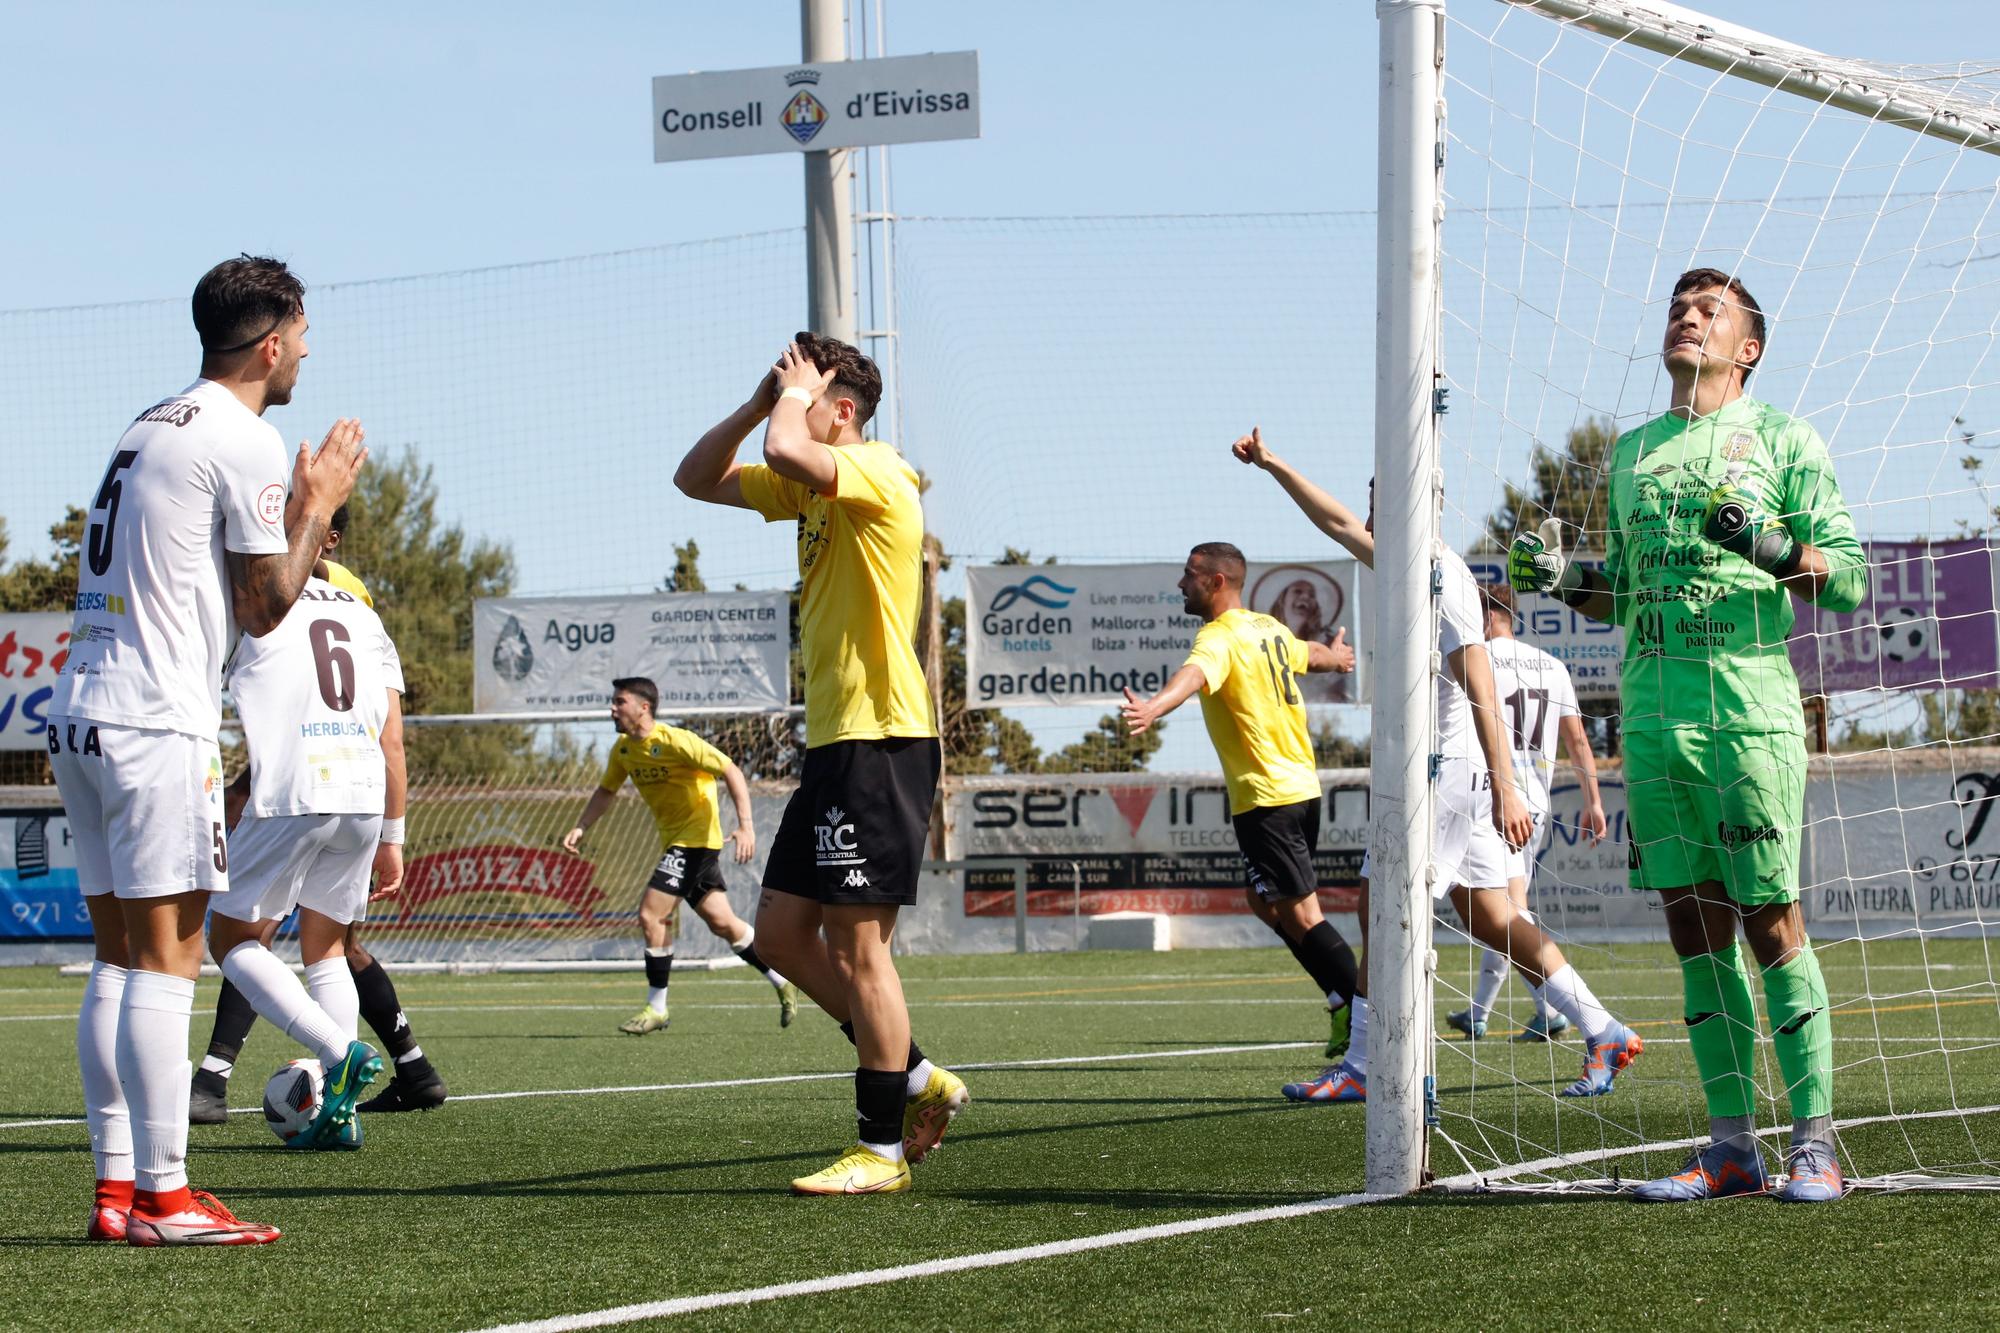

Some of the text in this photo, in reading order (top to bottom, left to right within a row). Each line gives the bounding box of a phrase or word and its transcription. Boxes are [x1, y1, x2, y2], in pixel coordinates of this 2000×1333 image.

[661, 89, 971, 134] Consell d'Eivissa
[1648, 491, 1711, 501] Mediterrá
[88, 449, 139, 577] 5
[1632, 523, 1700, 544] BLAKST
[1868, 548, 1946, 602] ELE
[300, 588, 355, 603] ALO
[1090, 593, 1117, 605] Live
[1158, 591, 1185, 605] Fee
[651, 607, 776, 623] GARDEN CENTER
[982, 612, 1072, 635] Garden
[1091, 616, 1156, 630] Mallorca
[543, 619, 616, 651] Agua
[1675, 617, 1736, 634] destino
[651, 635, 698, 645] PLANTAS
[699, 635, 706, 643] Y
[1003, 637, 1052, 652] hotels
[1091, 636, 1191, 651] Ibiza Huelva
[1685, 633, 1726, 649] pacha
[308, 618, 356, 713] 6
[1260, 635, 1299, 707] 18
[978, 664, 1169, 700] gardenhotel
[1504, 687, 1549, 752] 17
[301, 722, 367, 737] HERBUSA
[814, 823, 858, 851] RC
[212, 821, 228, 874] 5
[828, 851, 858, 859] CENTRAL
[1047, 873, 1084, 883] CANAL
[1087, 873, 1109, 883] SUR
[1567, 902, 1601, 915] bajos
[1825, 886, 1915, 913] PINTURA
[11, 902, 61, 924] 971
